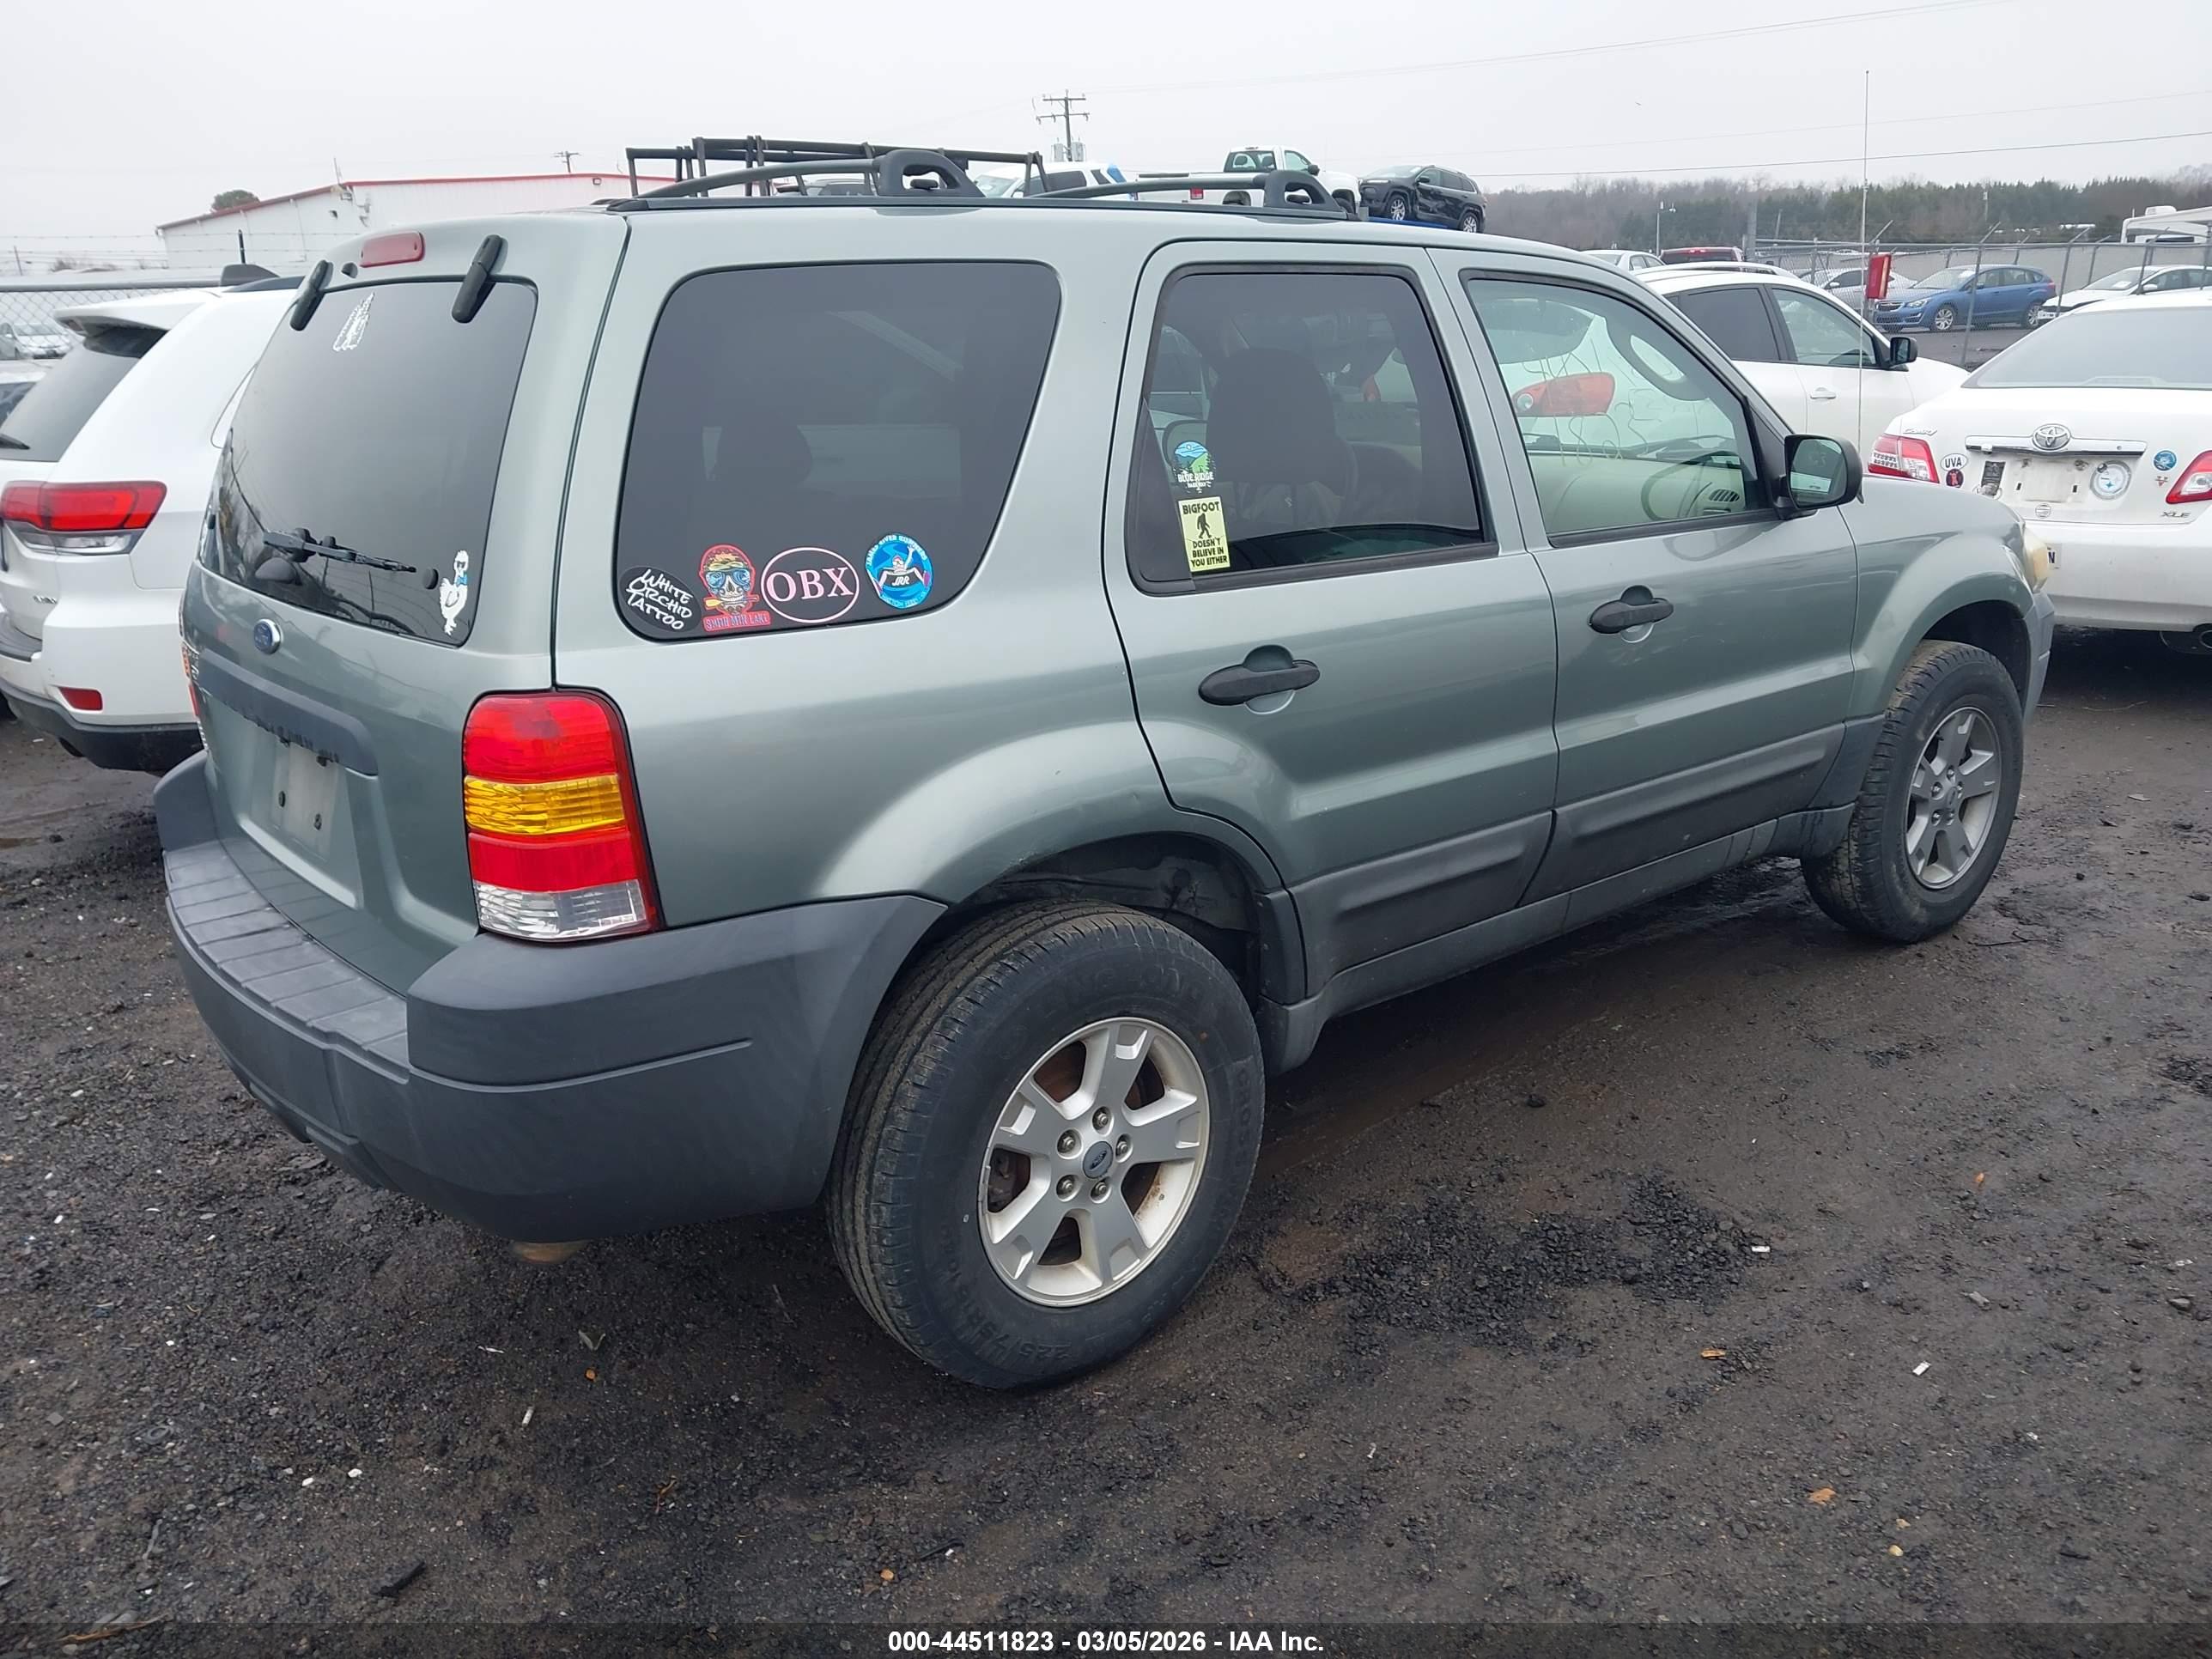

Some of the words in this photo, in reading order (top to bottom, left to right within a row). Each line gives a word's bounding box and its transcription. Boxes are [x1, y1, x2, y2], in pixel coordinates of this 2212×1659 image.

[1945, 457, 1962, 469] UVA
[1182, 501, 1220, 515] BIGFOOT
[2160, 510, 2191, 519] XLE
[1193, 537, 1220, 550] DOESN'T
[1192, 548, 1217, 558] BELIEVE
[1218, 546, 1224, 555] IN
[1190, 558, 1206, 568] YOU
[1206, 555, 1228, 566] EITHER
[639, 568, 694, 605] WHITE
[766, 566, 854, 602] OBX
[629, 576, 693, 618] ORCHID
[625, 588, 684, 629] TATTOO
